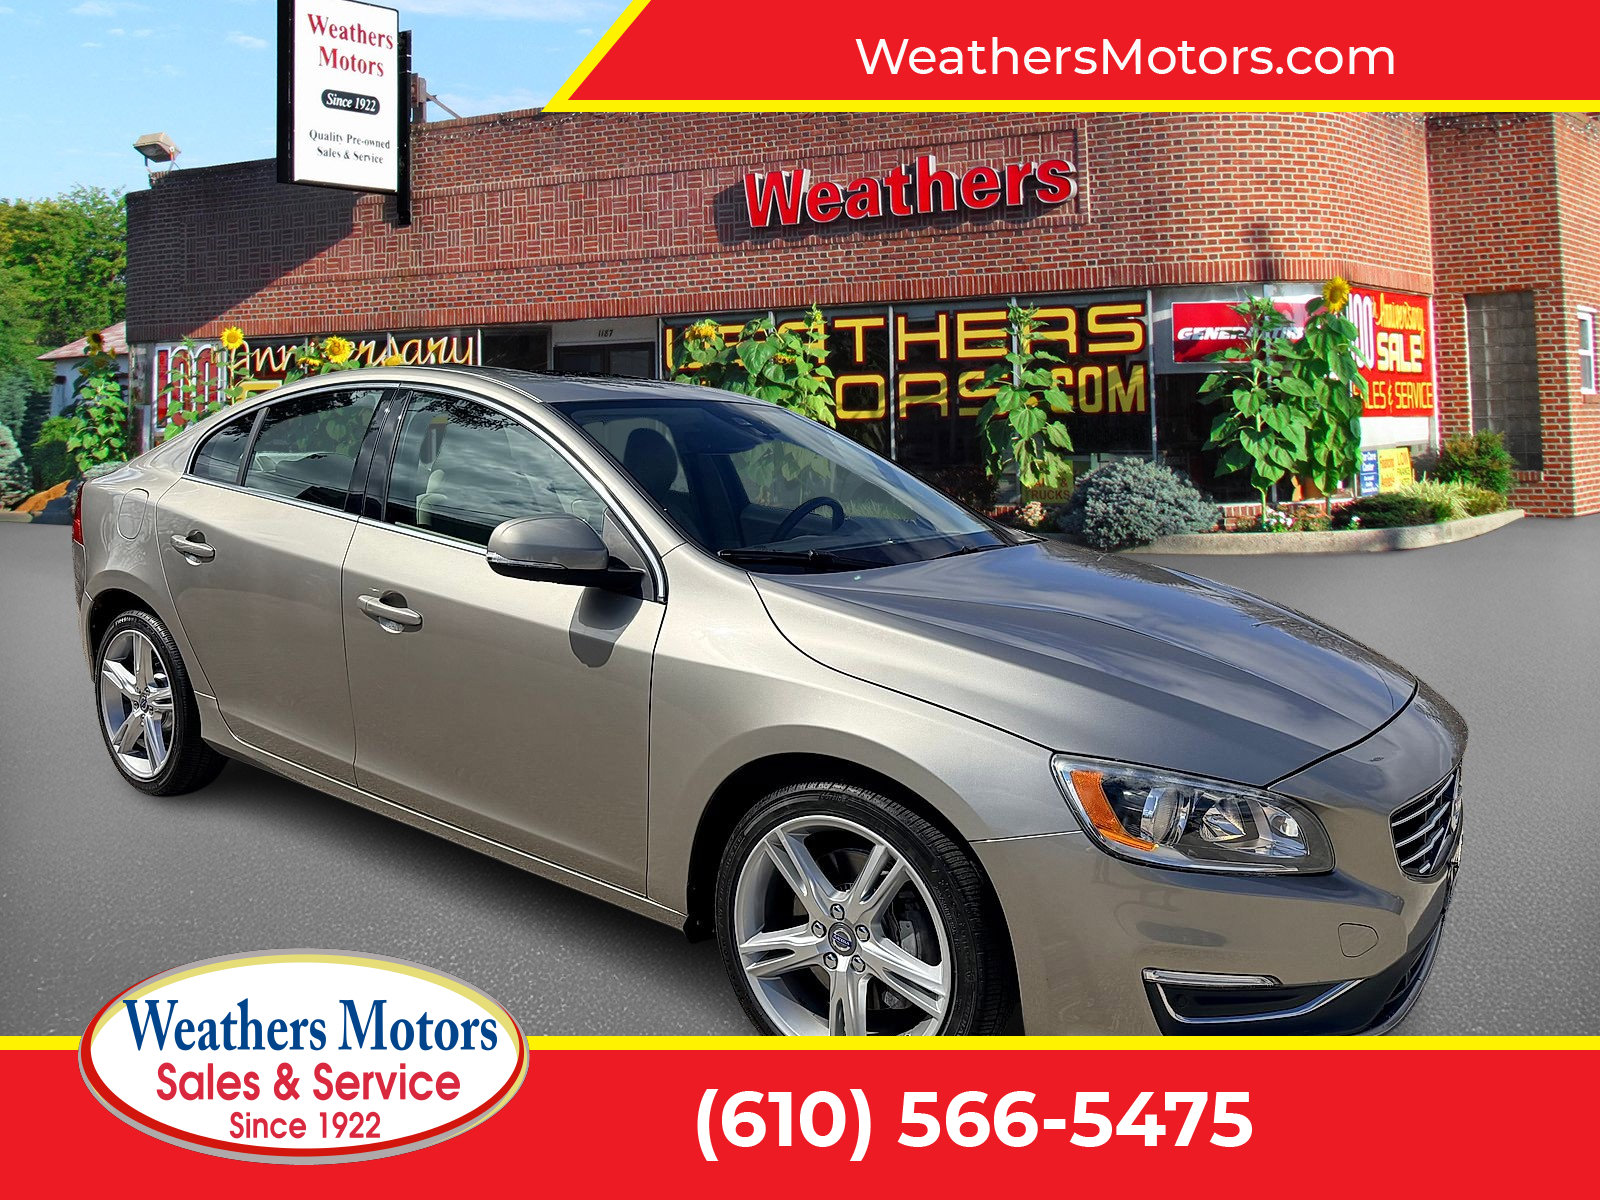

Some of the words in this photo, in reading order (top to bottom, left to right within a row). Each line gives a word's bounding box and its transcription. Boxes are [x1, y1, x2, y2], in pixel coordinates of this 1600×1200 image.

[307, 13, 394, 50] Weathers
[318, 46, 385, 77] Motors
[326, 93, 352, 109] Since
[355, 98, 377, 112] 1922
[309, 129, 343, 144] Quality
[346, 133, 391, 149] Pre-owned
[316, 146, 341, 158] Sales
[344, 150, 350, 160] &
[353, 151, 384, 164] Service
[743, 155, 1078, 228] Weathers
[598, 329, 614, 338] 1187
[1376, 331, 1423, 373] SALE
[1352, 380, 1387, 409] LES
[1395, 381, 1434, 409] SERVICE
[1025, 489, 1070, 501] RUCKS
